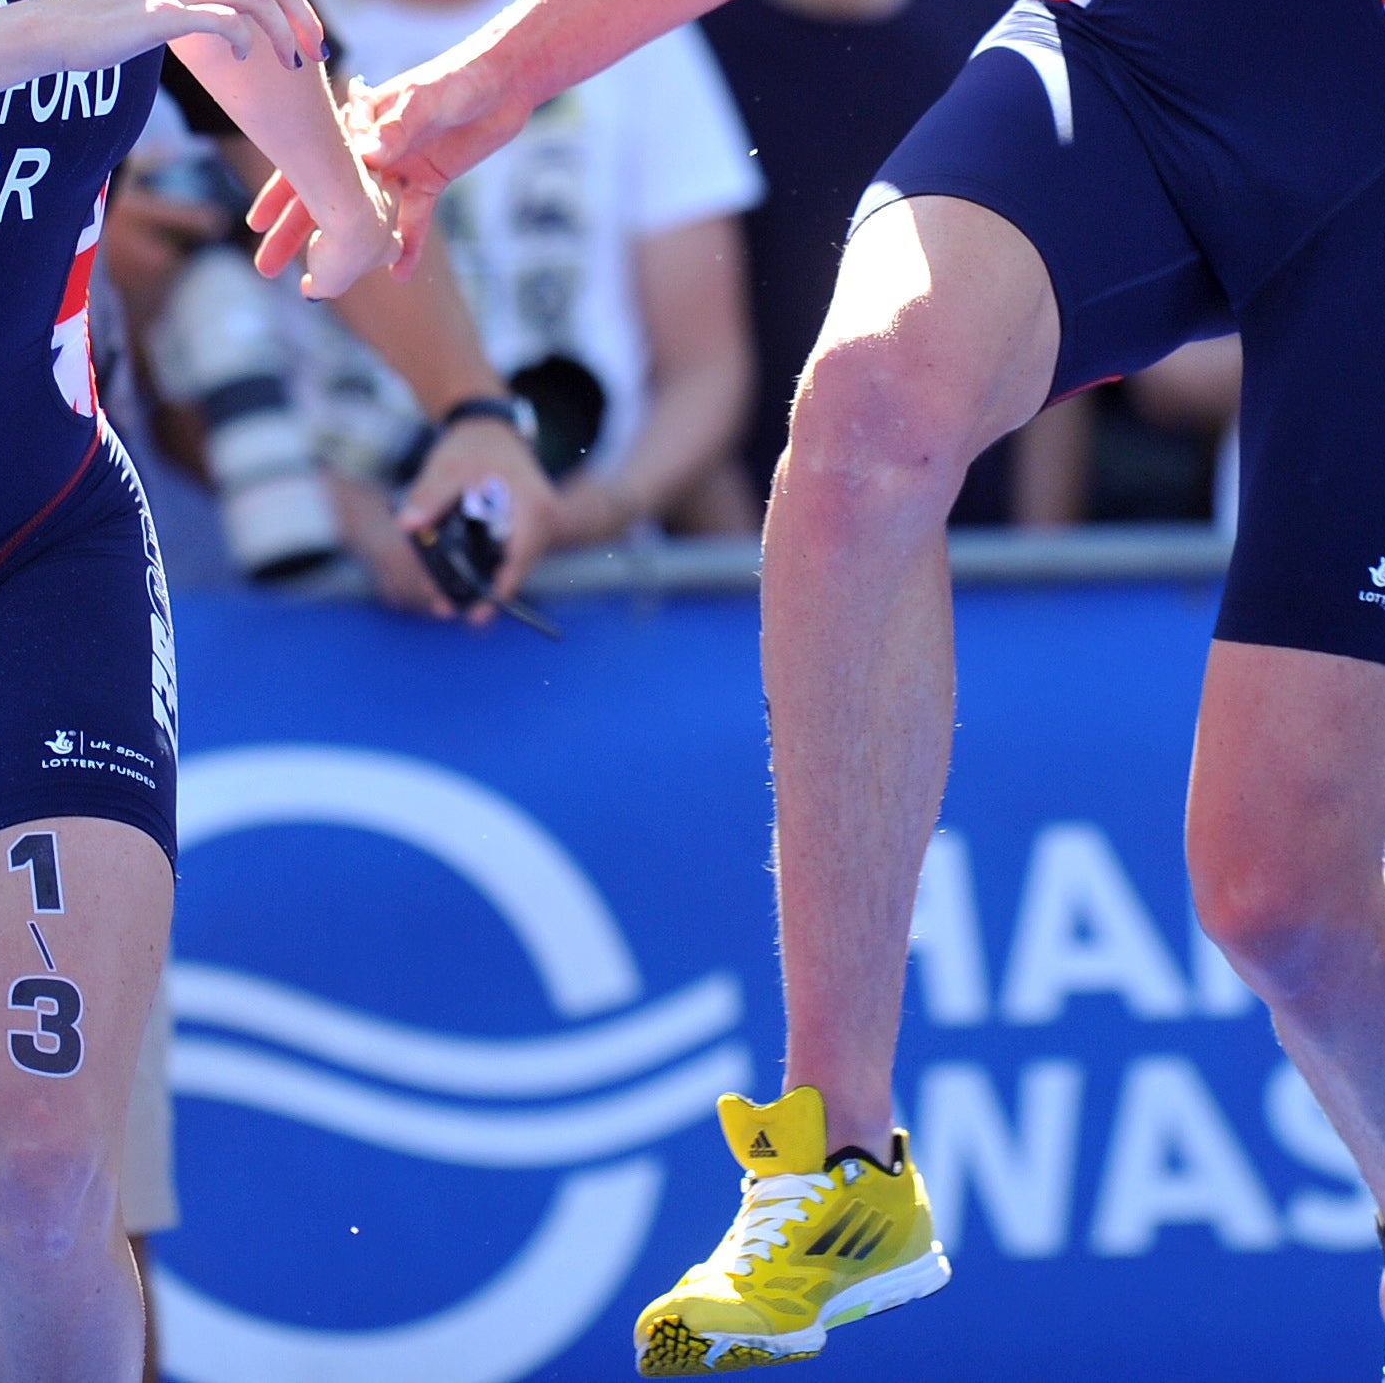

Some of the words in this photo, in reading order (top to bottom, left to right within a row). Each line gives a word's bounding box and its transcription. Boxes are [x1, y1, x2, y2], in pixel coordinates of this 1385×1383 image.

[41, 758, 105, 770] LOTTERY
[109, 763, 157, 790] FUNDED
[89, 740, 112, 751] uk
[115, 746, 155, 769] sport
[7, 830, 66, 914] 1
[6, 974, 86, 1079] 3
